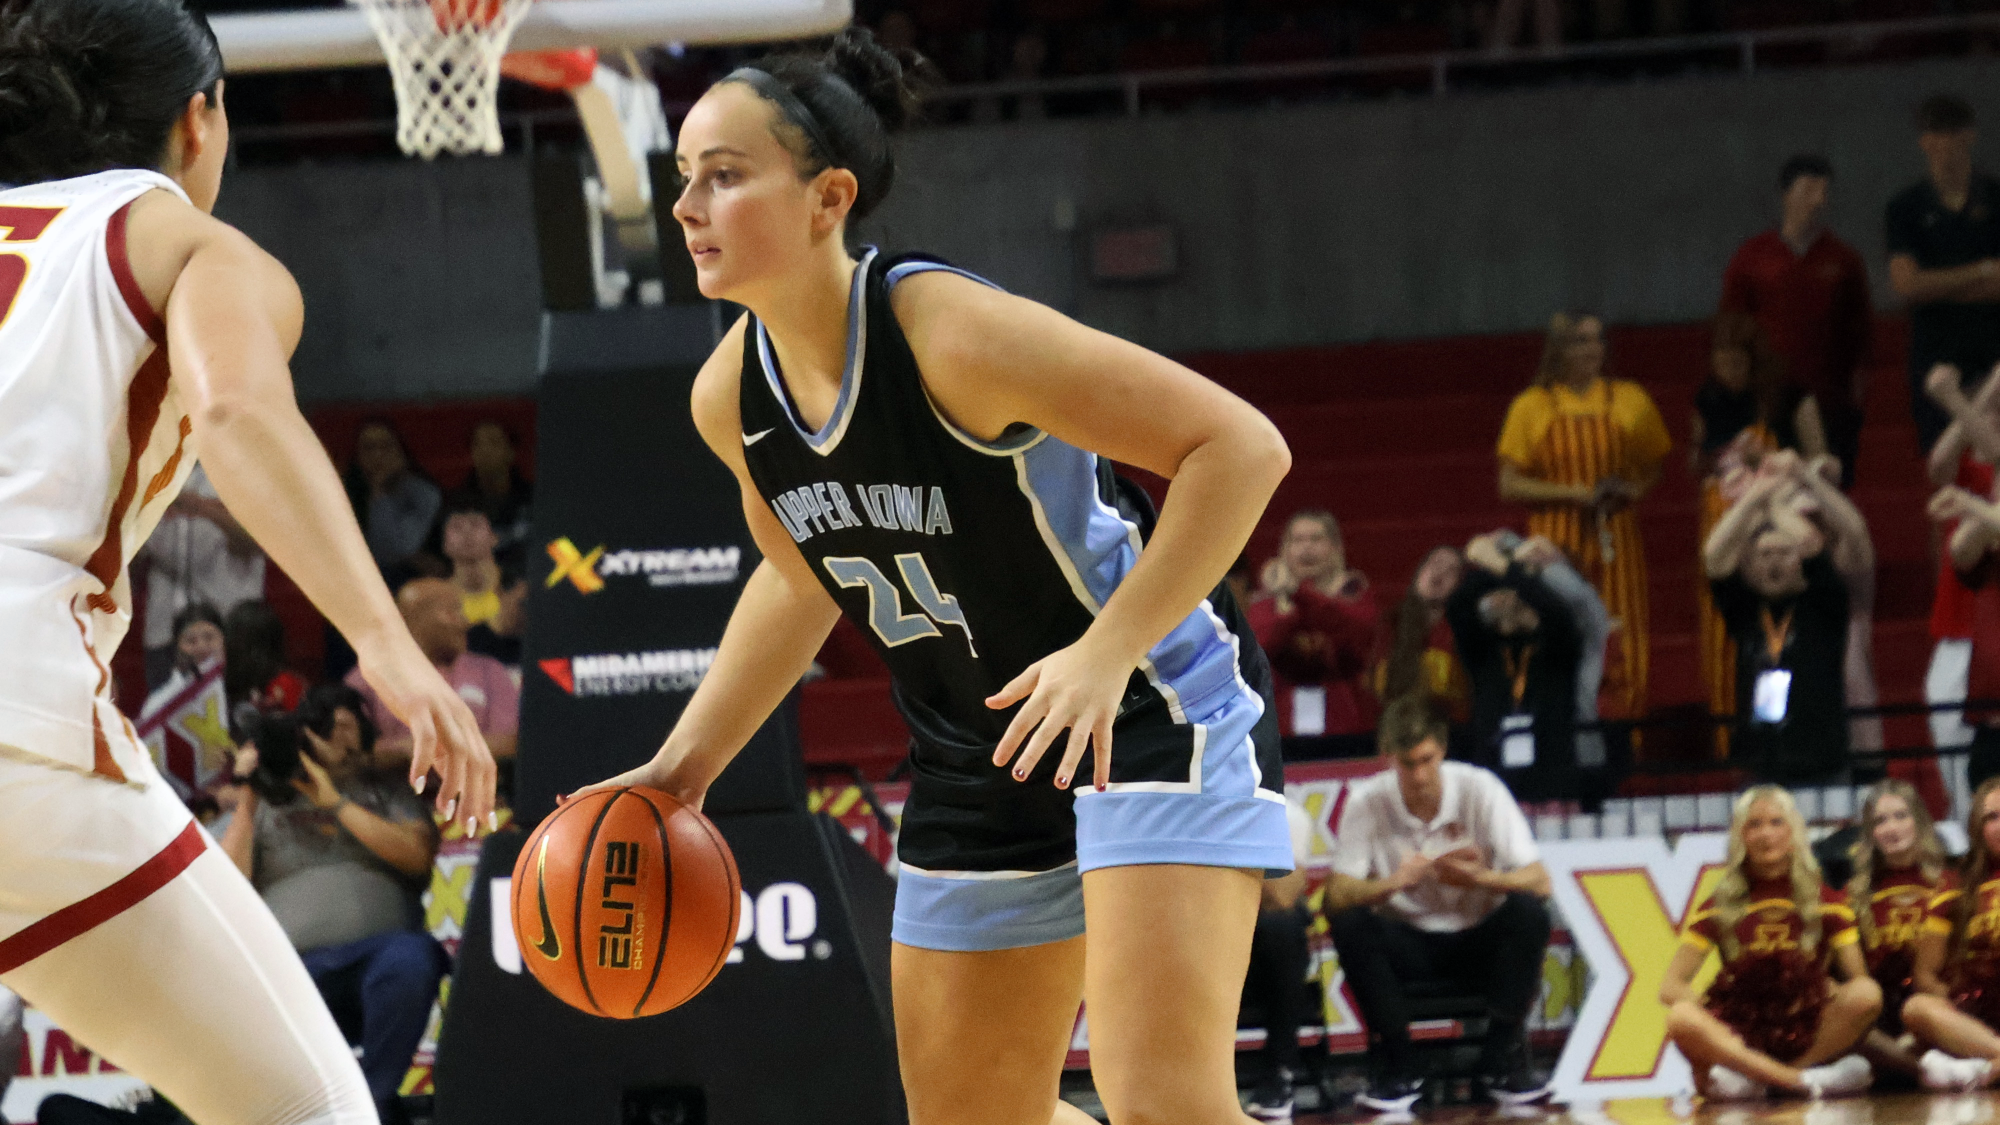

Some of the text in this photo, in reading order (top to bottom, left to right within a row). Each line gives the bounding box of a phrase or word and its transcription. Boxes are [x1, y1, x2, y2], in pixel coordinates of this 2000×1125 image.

[771, 481, 953, 543] UPPER IOWA
[600, 546, 741, 577] XTREAM
[823, 552, 979, 658] 24
[598, 841, 639, 970] ELITE
